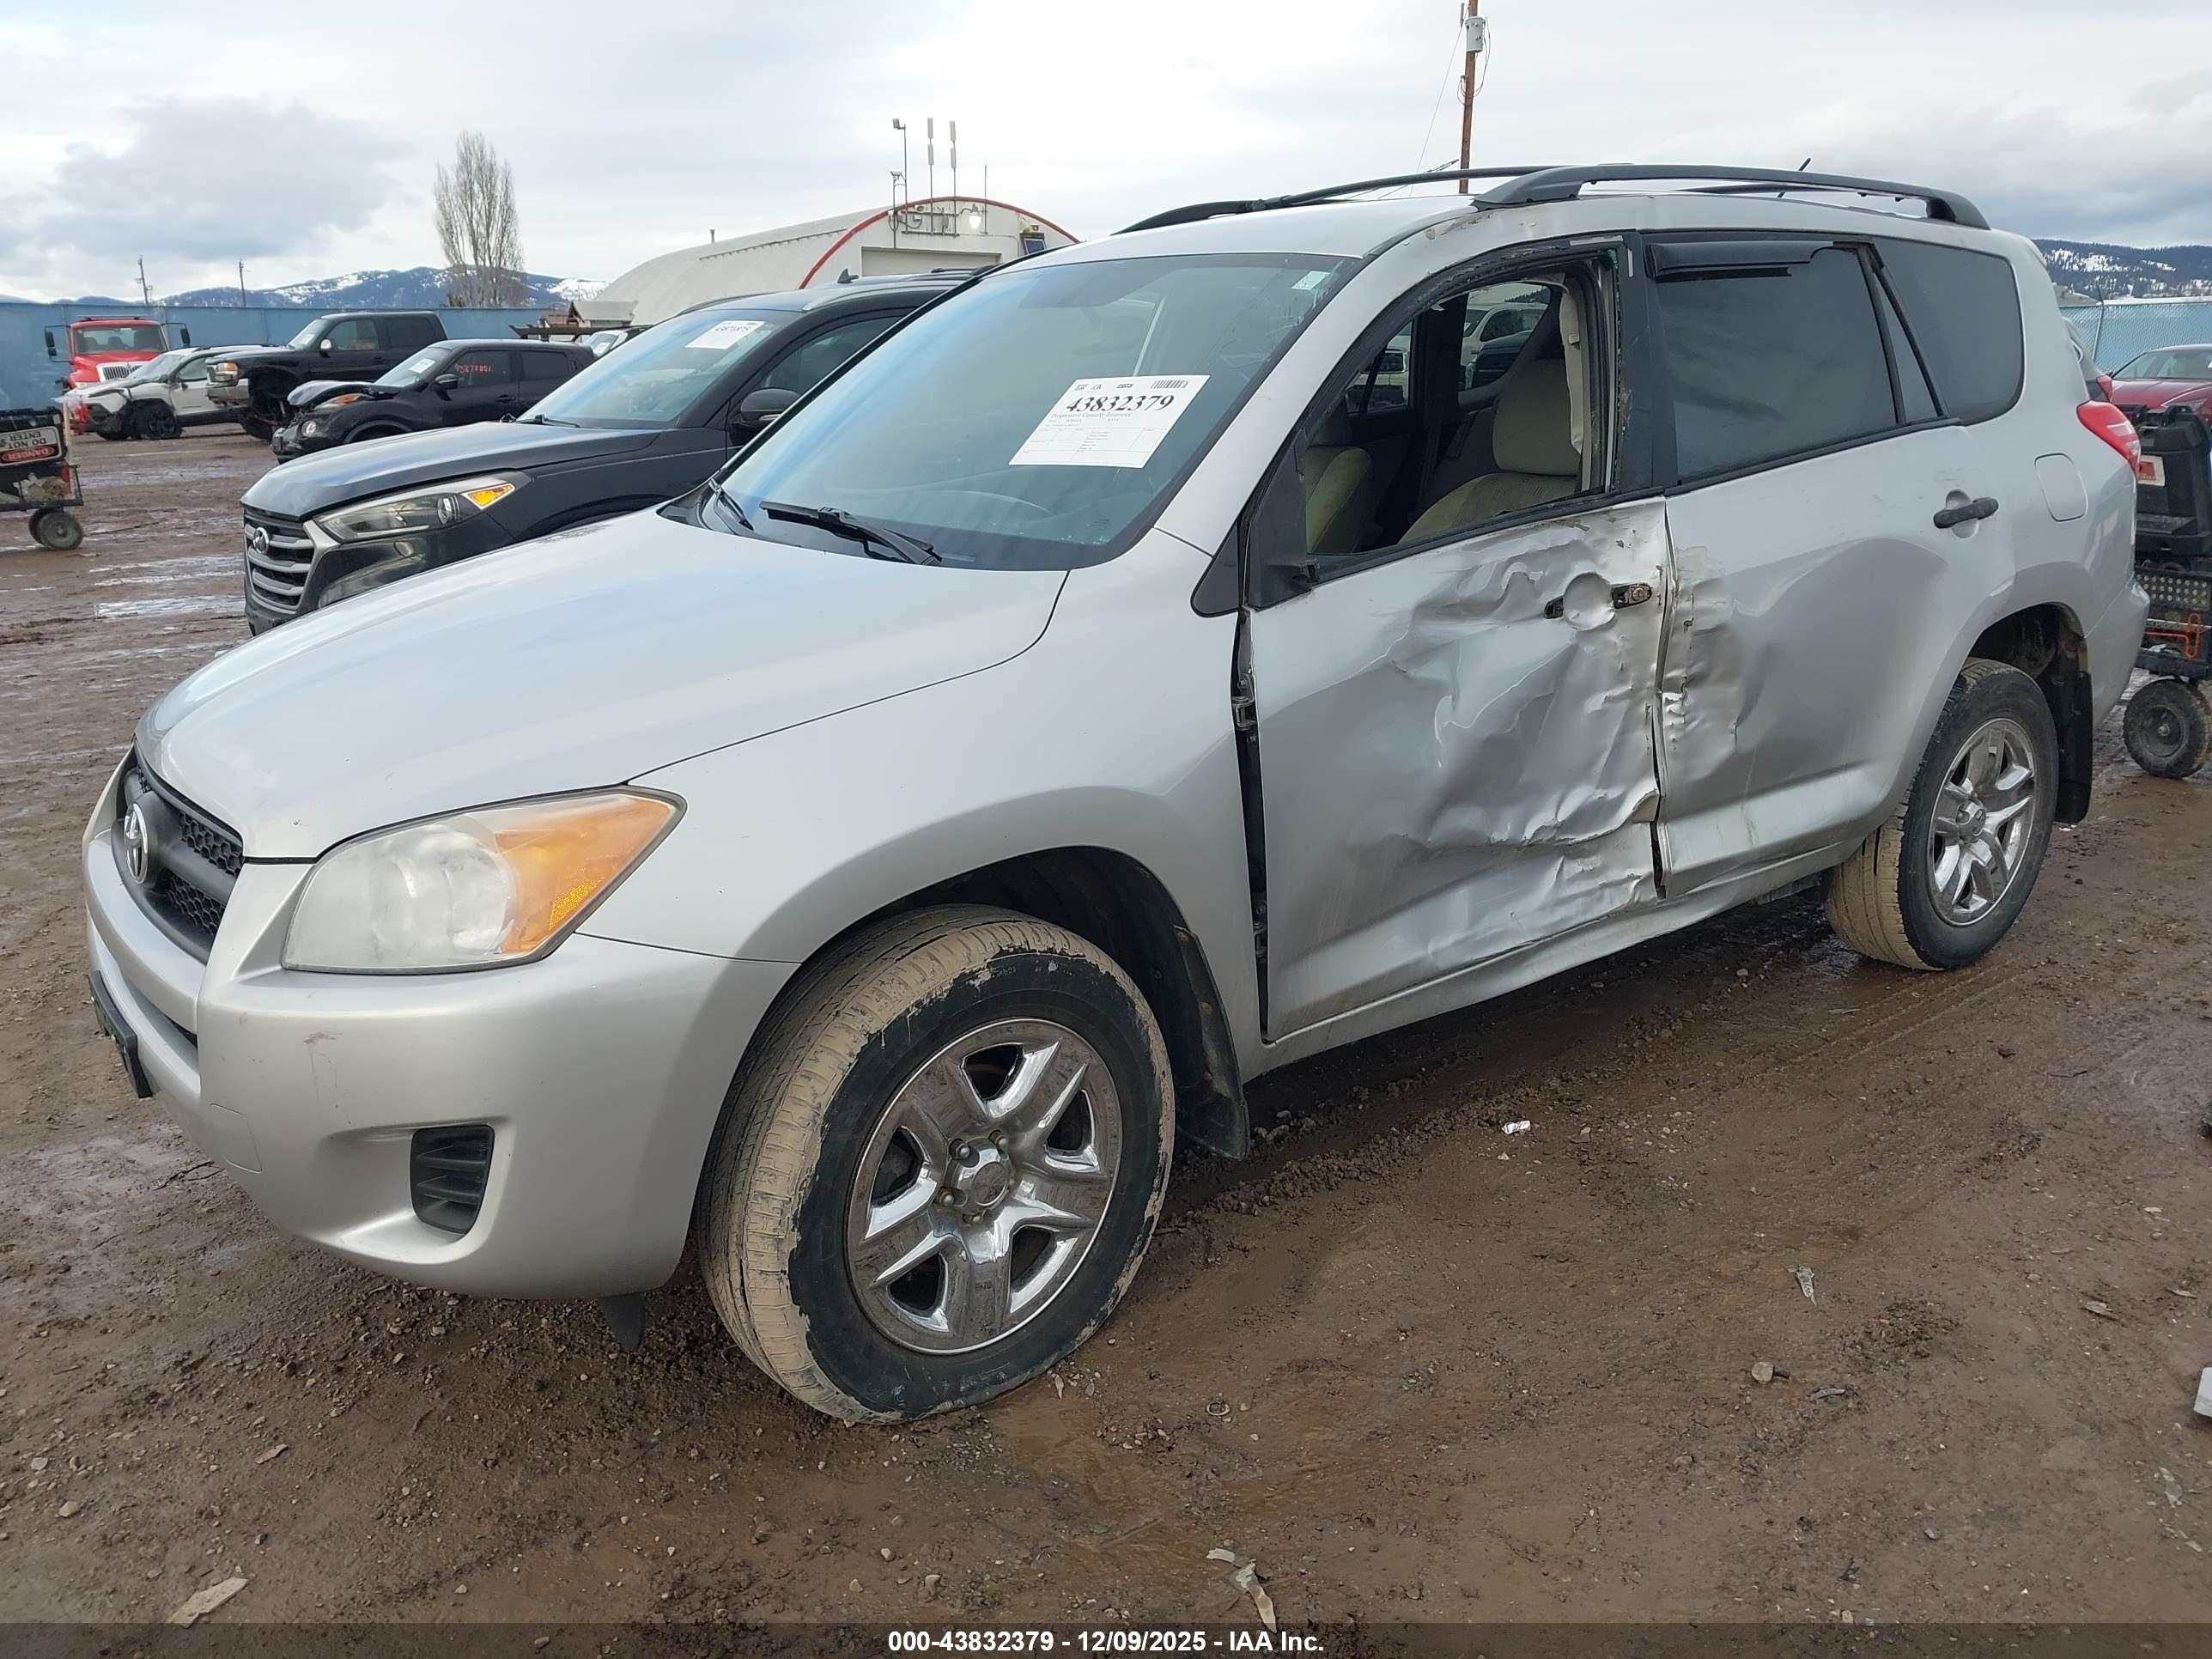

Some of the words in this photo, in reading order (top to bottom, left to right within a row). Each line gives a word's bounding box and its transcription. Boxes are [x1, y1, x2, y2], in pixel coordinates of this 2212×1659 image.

[1066, 394, 1175, 412] 43832379
[9, 432, 41, 441] ENTER
[8, 441, 28, 449] NOT
[9, 448, 49, 460] DANGER
